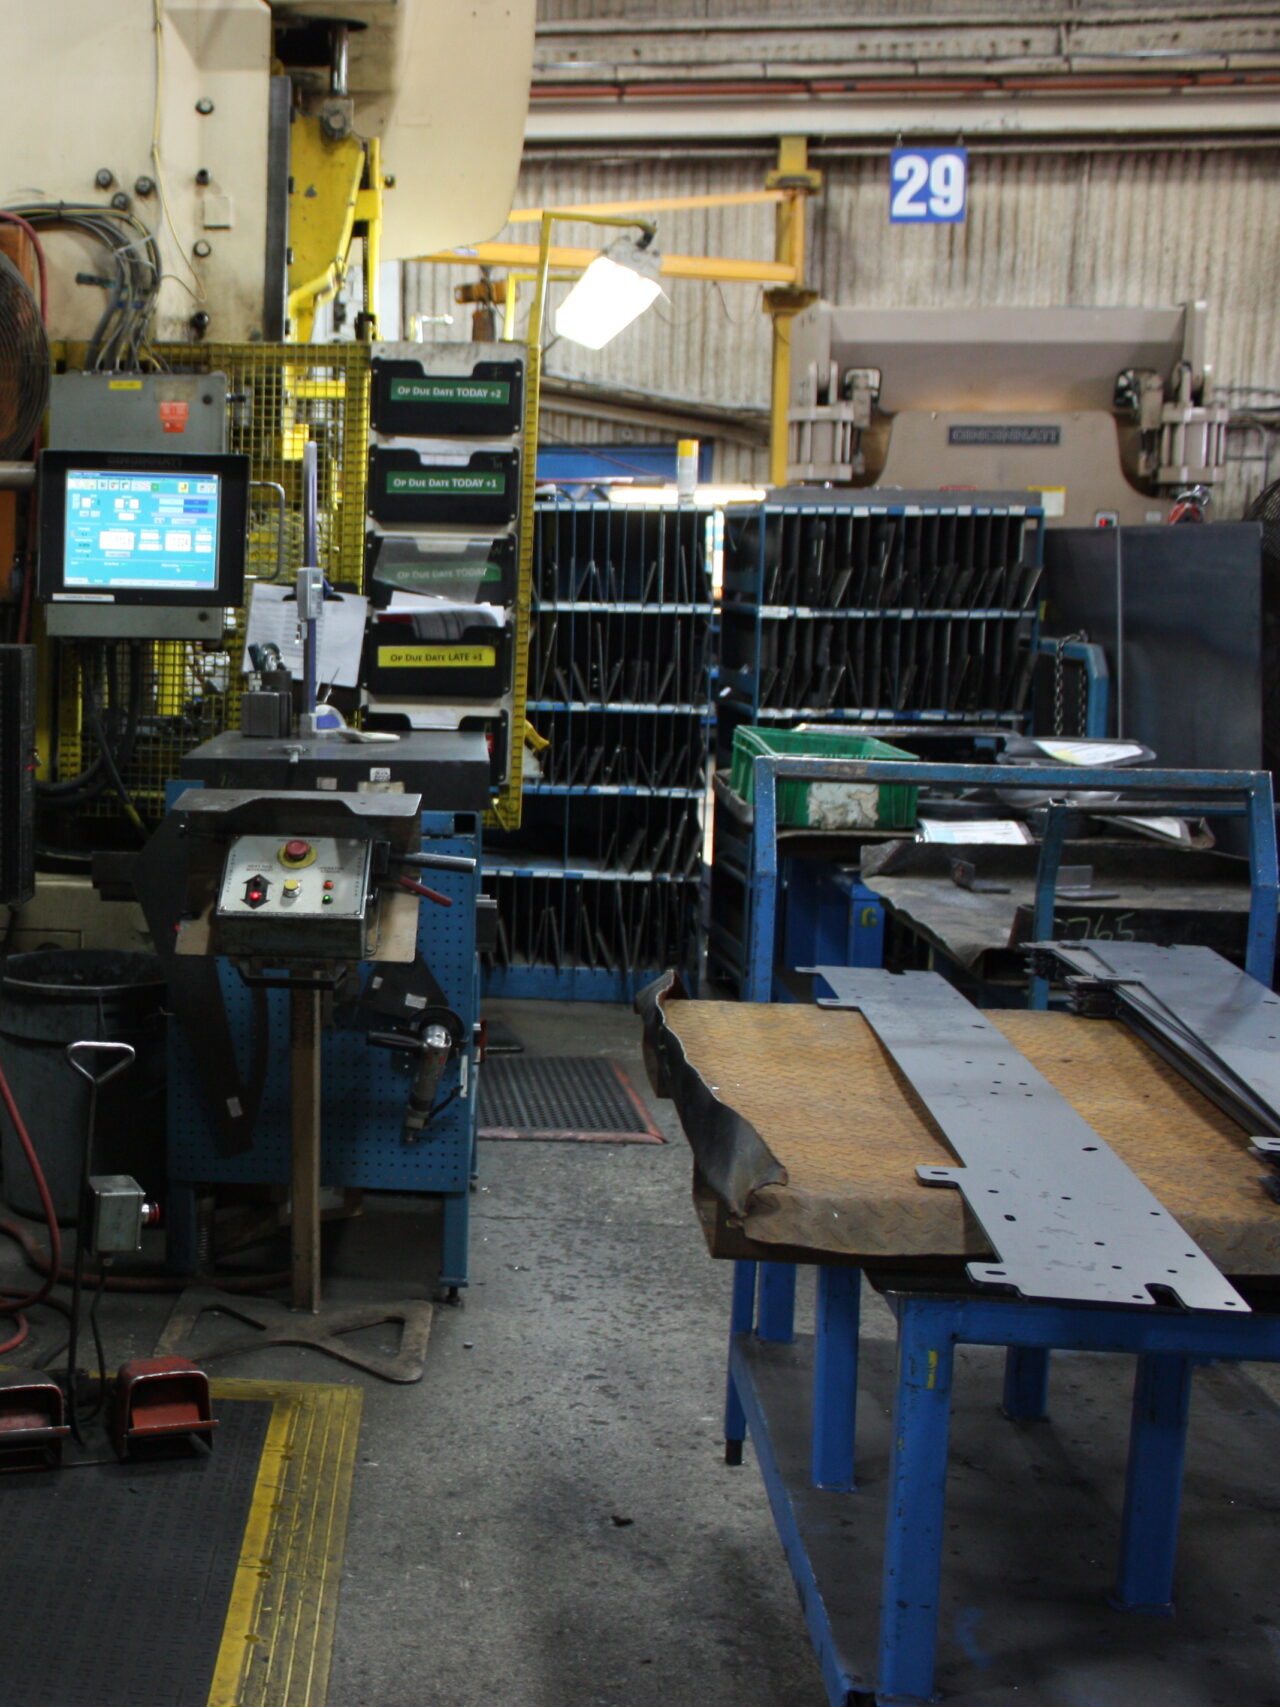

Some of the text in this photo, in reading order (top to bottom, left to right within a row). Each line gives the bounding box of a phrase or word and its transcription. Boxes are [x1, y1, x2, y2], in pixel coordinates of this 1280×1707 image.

[891, 154, 965, 217] 29
[457, 387, 488, 398] TODAY
[490, 388, 502, 398] +2
[952, 428, 1057, 442] CINCINNATI
[451, 478, 484, 488] TODAY
[486, 479, 497, 488] +1
[455, 567, 487, 578] TODAY
[448, 653, 470, 661] LATE
[472, 653, 483, 661] +1
